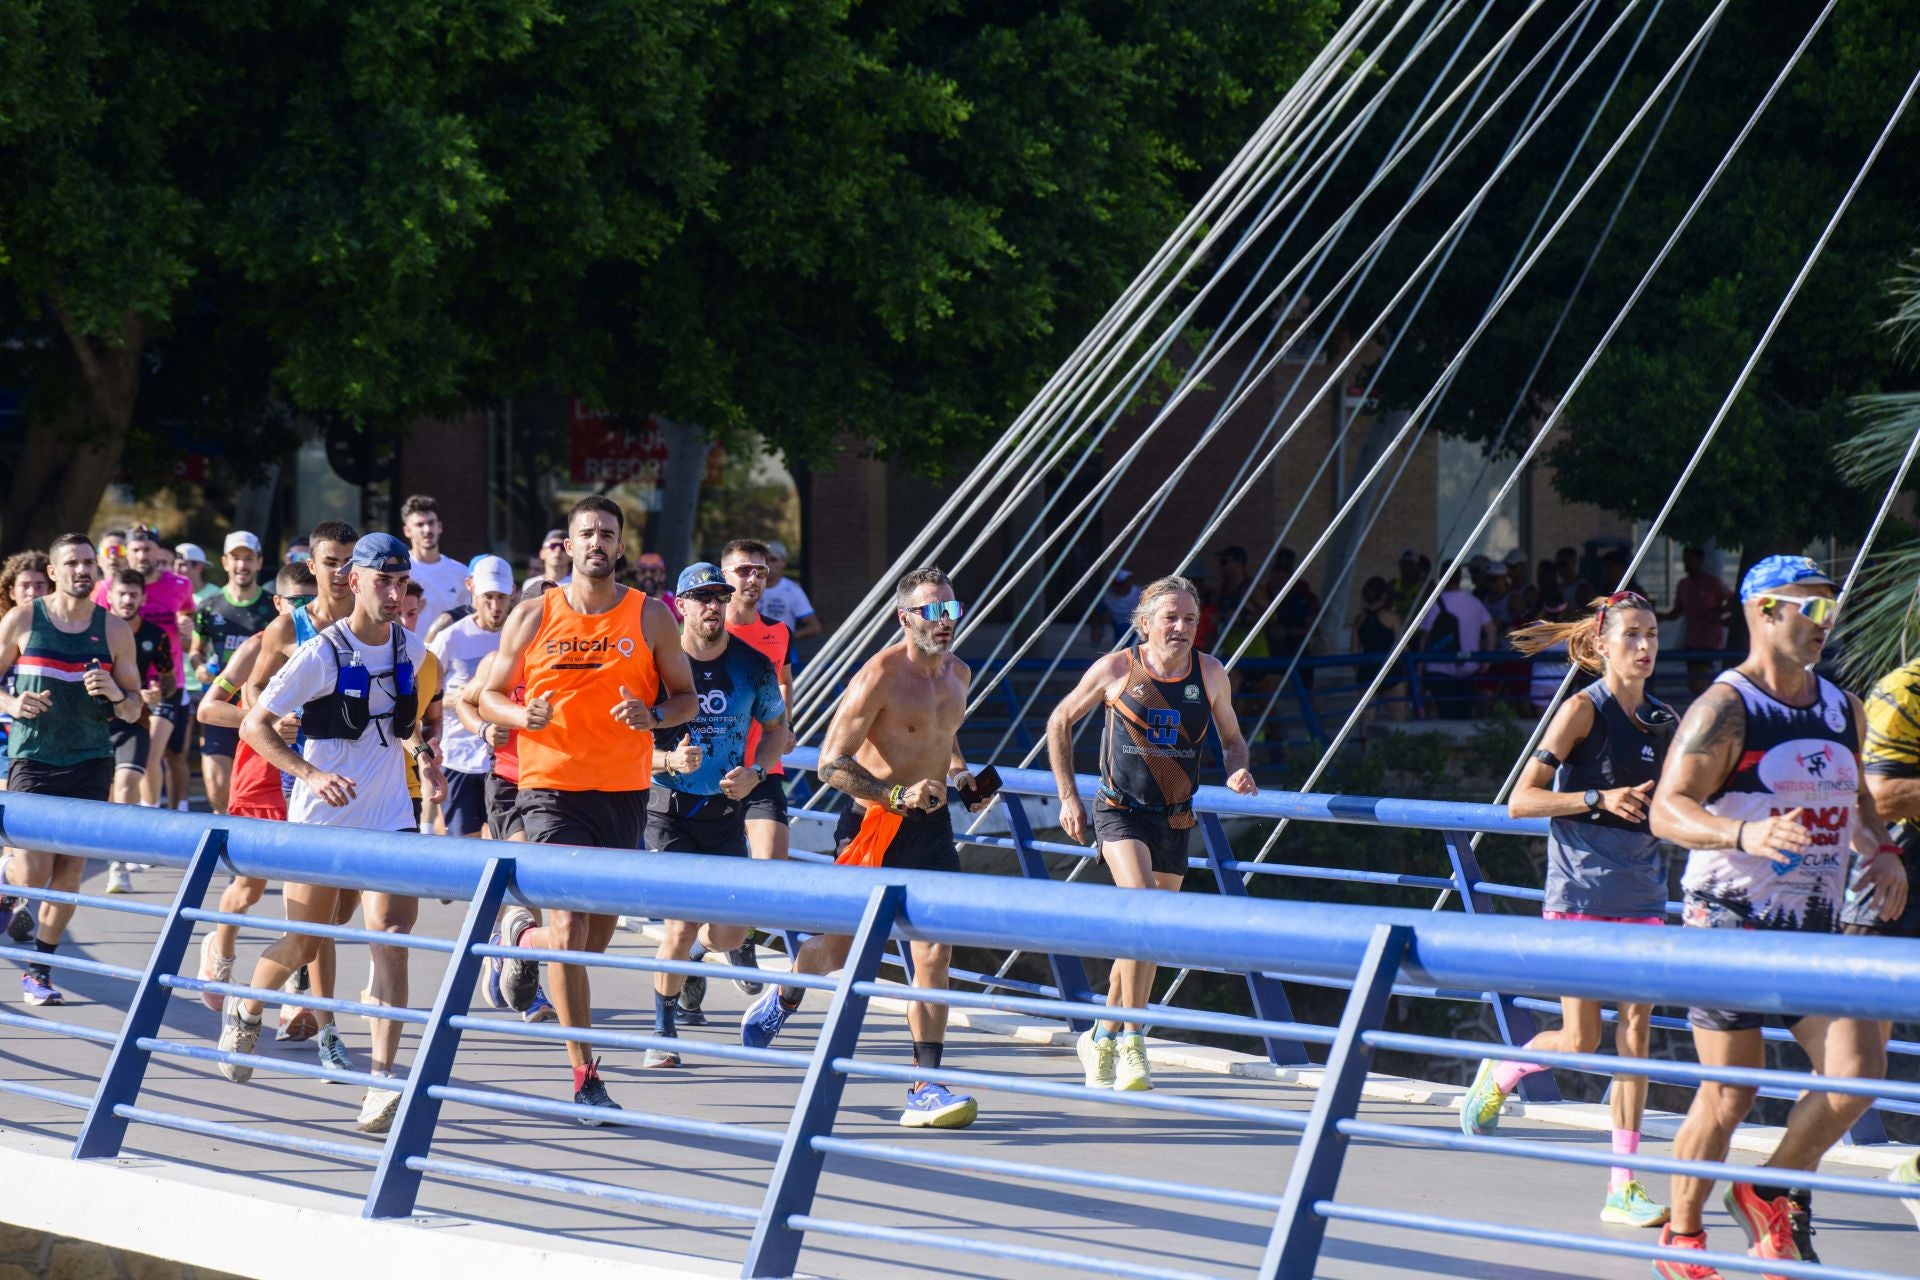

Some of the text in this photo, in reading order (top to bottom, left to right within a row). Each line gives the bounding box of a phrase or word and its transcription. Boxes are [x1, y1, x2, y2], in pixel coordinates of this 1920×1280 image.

[585, 456, 666, 481] REFOR
[546, 636, 635, 658] Epical-Q
[1818, 780, 1856, 791] FITNESS
